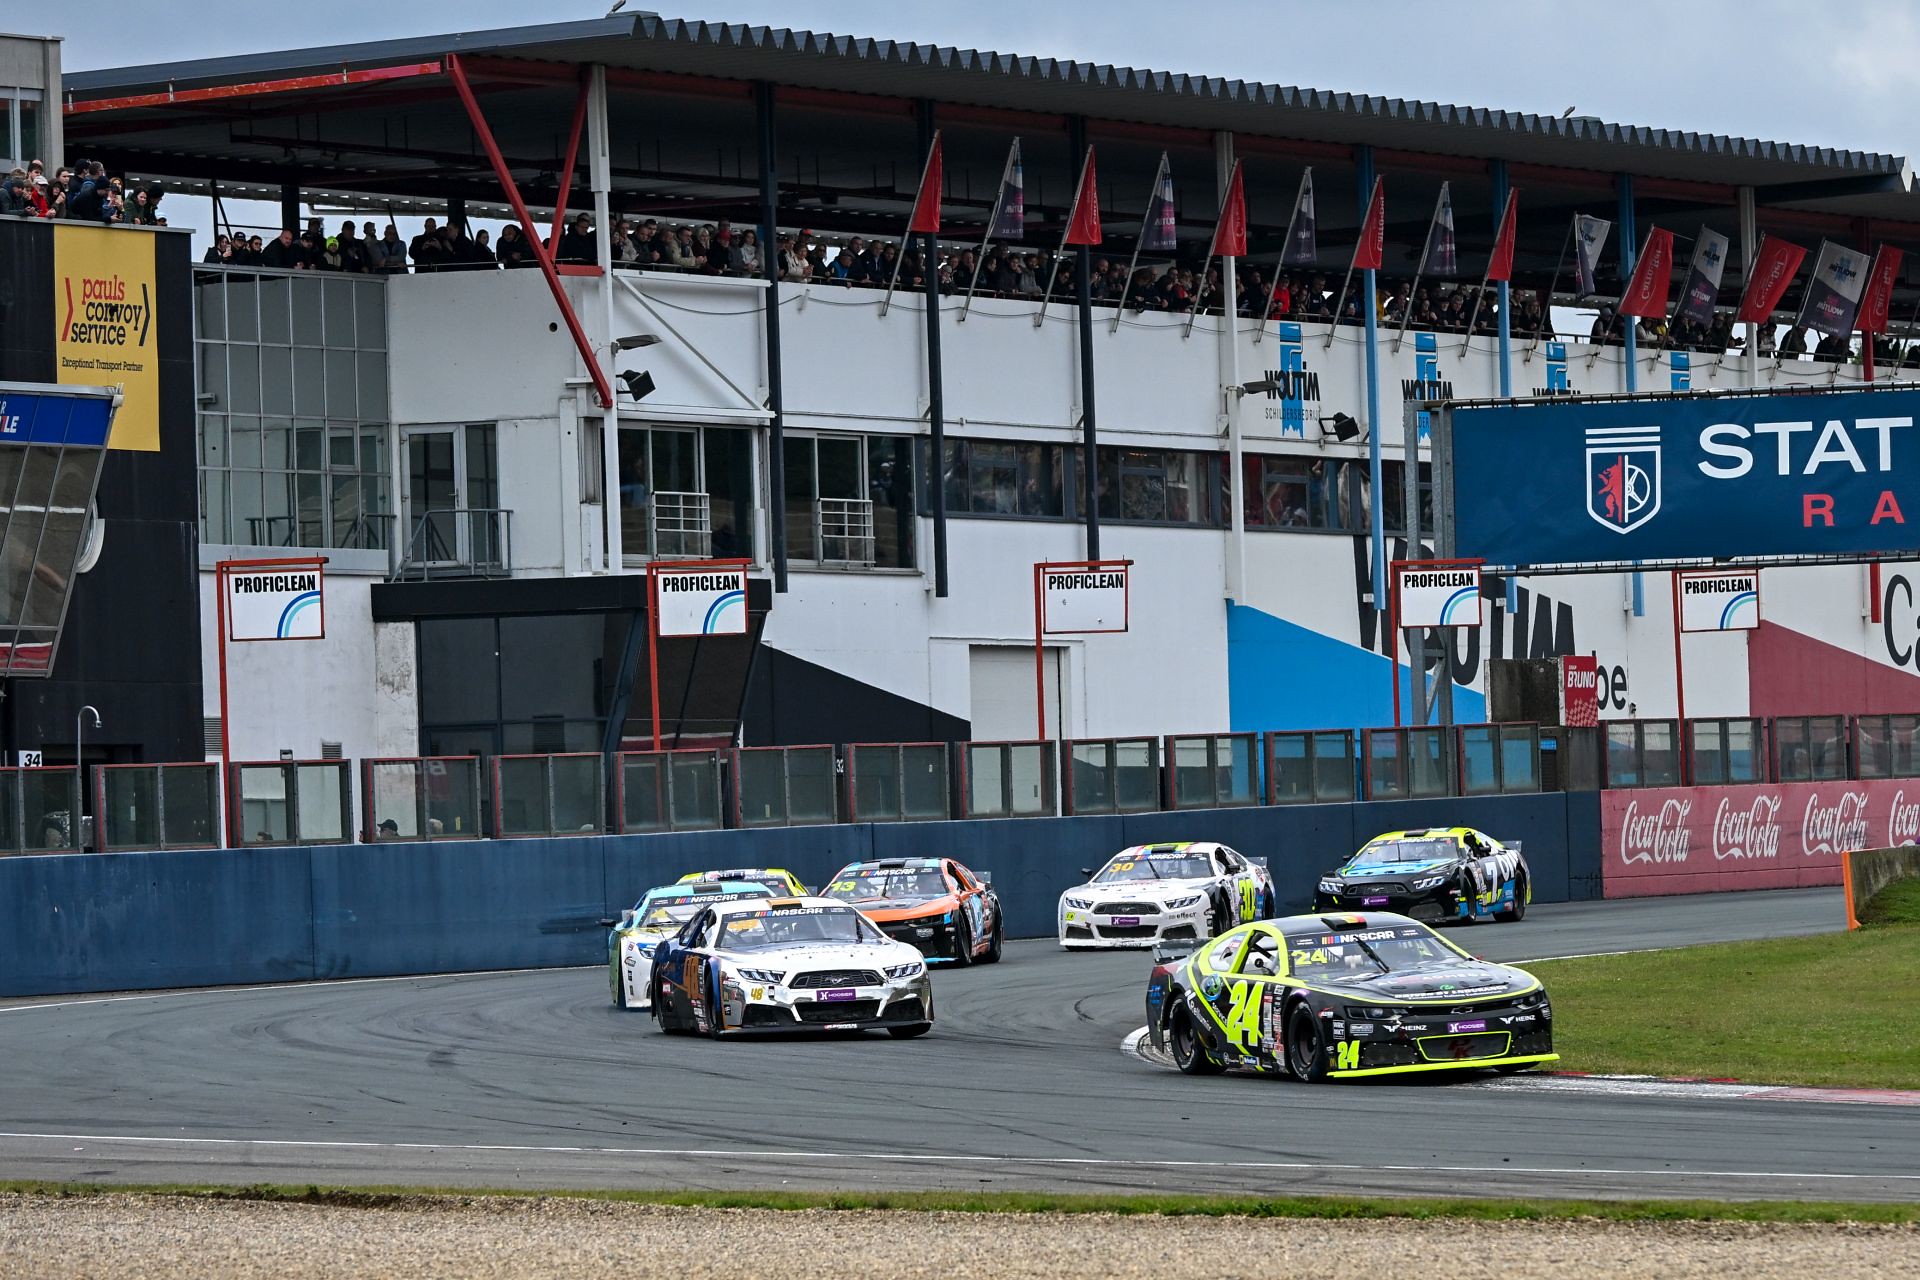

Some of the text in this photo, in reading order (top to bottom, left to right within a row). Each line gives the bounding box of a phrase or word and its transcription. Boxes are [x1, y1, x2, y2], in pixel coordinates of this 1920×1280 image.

[82, 274, 125, 305] pauls
[86, 301, 143, 331] convoy
[71, 322, 126, 346] service
[62, 357, 143, 372] Exceptional Transport Partner
[1264, 361, 1320, 401] WOUTIM
[0, 416, 20, 433] ILE
[1698, 417, 1913, 479] STAT
[235, 575, 316, 593] PROFICLEAN
[663, 575, 740, 592] PROFICLEAN
[1048, 574, 1124, 590] PROFICLEAN
[1404, 573, 1474, 588] PROFICLEAN
[1684, 578, 1752, 594] PROFICLEAN
[1884, 574, 1920, 673] C
[1568, 671, 1596, 688] BRUNO
[24, 753, 41, 767] 34
[1620, 799, 1692, 865] Coca-Cola
[1713, 794, 1782, 860] Coca-Cola
[874, 868, 916, 876] NASCAR
[1109, 862, 1135, 873] 30
[830, 881, 857, 893] 13
[1484, 861, 1497, 903] 7
[690, 894, 738, 903] NASCAR
[1238, 878, 1256, 920] 30
[771, 908, 823, 917] NASCAR
[1340, 931, 1396, 944] NASCAR
[1291, 948, 1328, 965] 24
[751, 988, 763, 1000] 48
[1227, 980, 1266, 1047] 24
[1515, 1014, 1537, 1022] HEINZ
[1458, 1022, 1486, 1030] HOOSIER
[1337, 1040, 1360, 1069] 24
